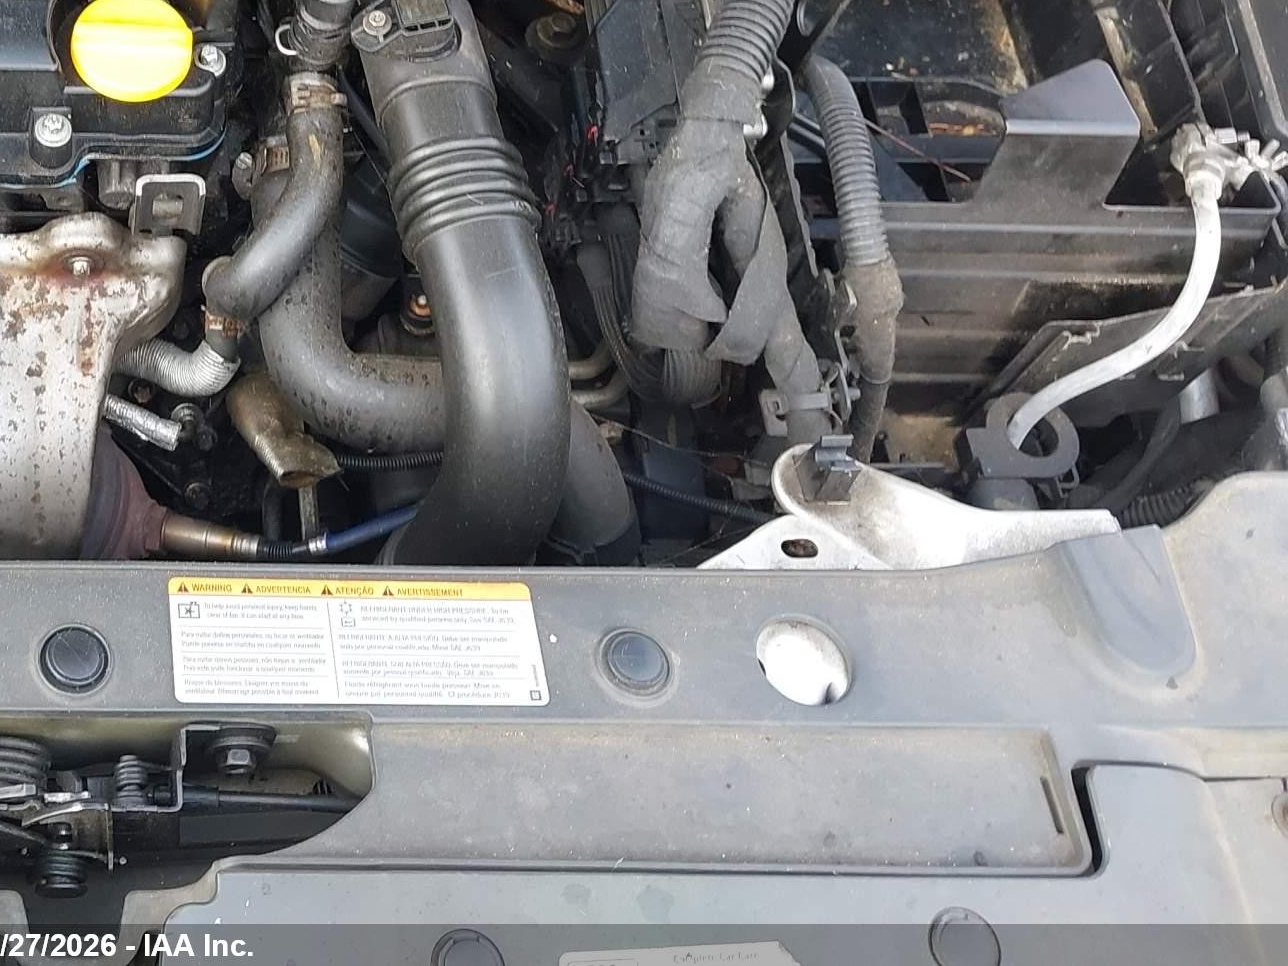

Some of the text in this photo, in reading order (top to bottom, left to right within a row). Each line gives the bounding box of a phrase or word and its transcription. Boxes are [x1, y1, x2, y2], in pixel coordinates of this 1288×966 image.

[191, 583, 463, 597] WARNING ADVERTENCIA ATENÇÃO AVERTISSEMENT
